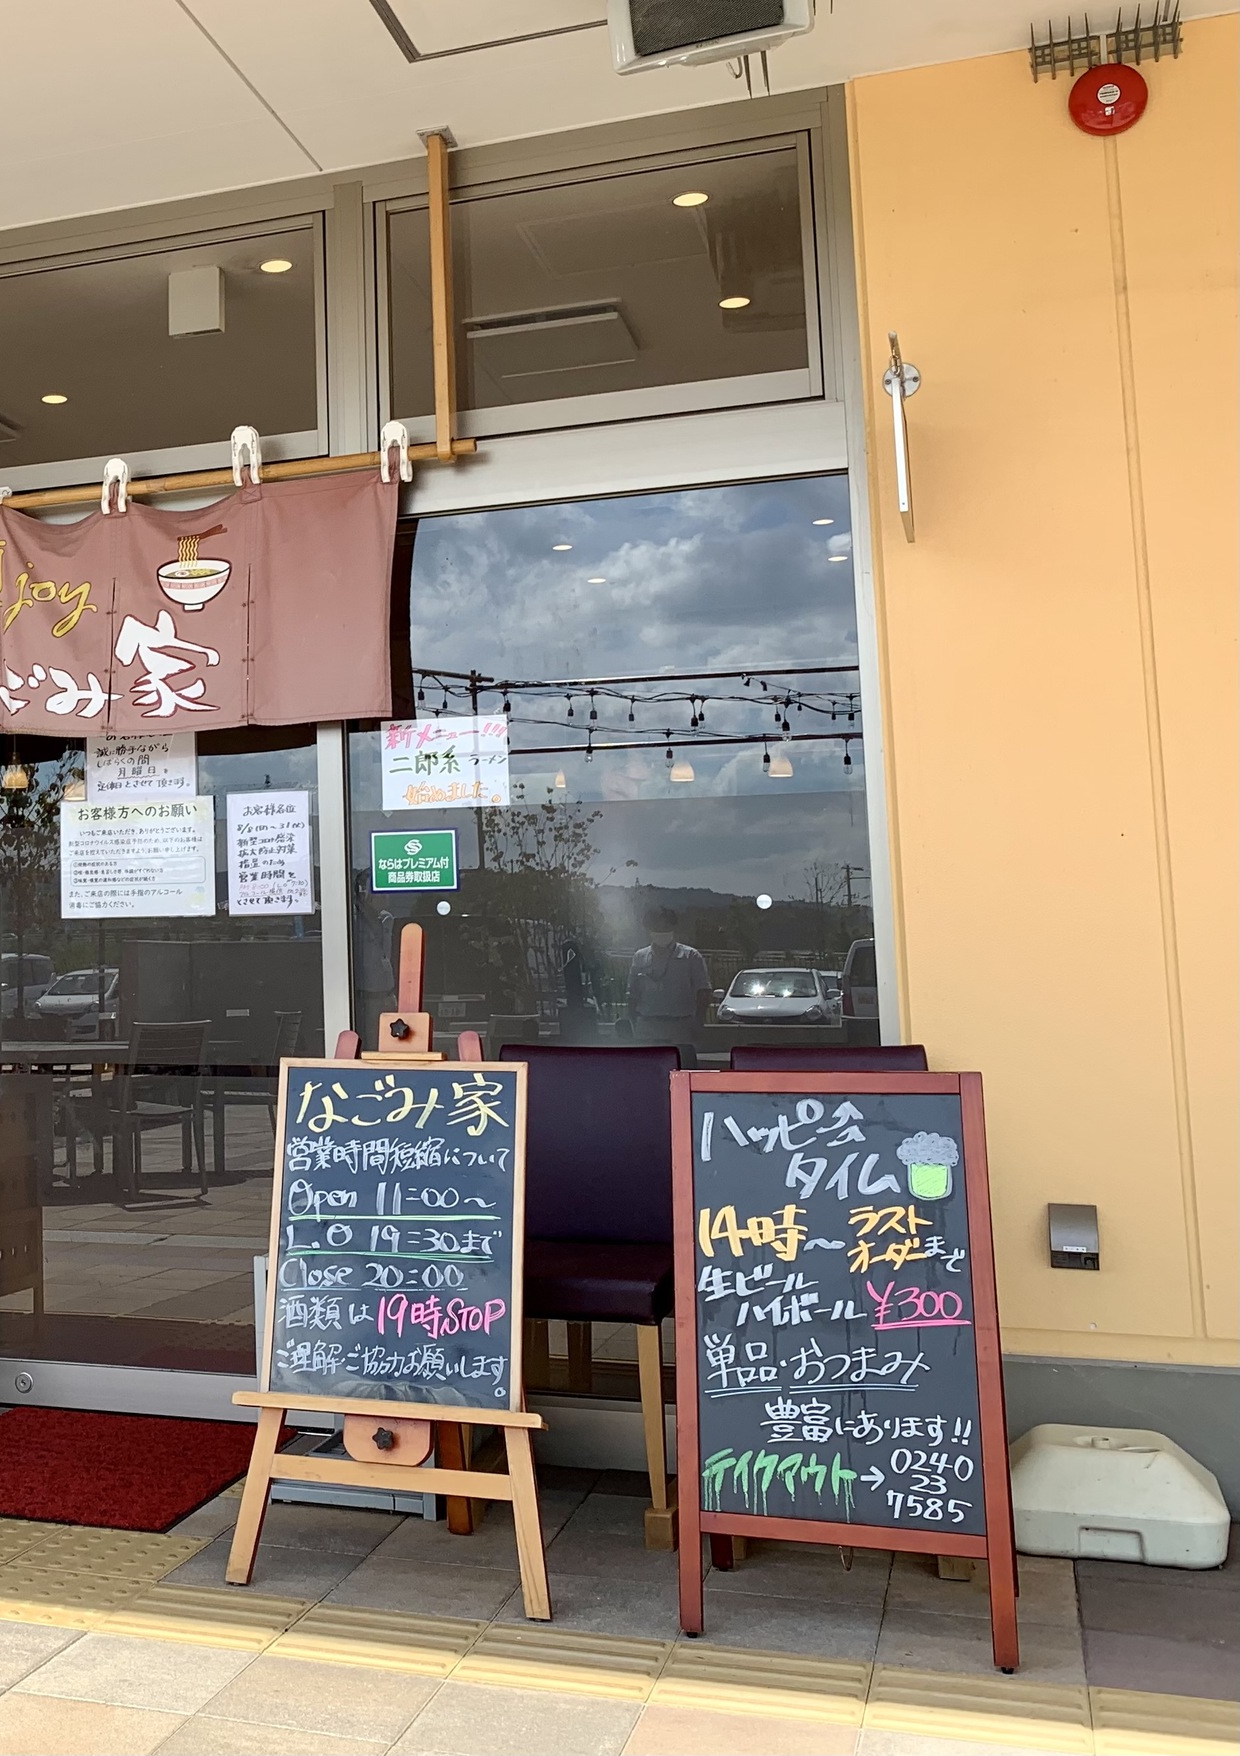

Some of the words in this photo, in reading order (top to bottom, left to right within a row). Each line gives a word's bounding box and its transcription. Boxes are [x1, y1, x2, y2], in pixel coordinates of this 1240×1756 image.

[95, 742, 169, 758] 誠に勝手ながら
[97, 754, 150, 768] しばらくの間
[389, 745, 461, 776] 二郎系
[468, 754, 507, 766] ラーメン
[403, 780, 502, 806] 始めました。
[77, 803, 198, 821] お客様方へのお願い
[378, 856, 450, 870] ならはプレミアム付
[387, 870, 441, 884] 商品券取扱店
[295, 1072, 510, 1136] なごみ家
[286, 1136, 511, 1174] 営業時間短縮について
[785, 1152, 901, 1200] タイム
[848, 1204, 934, 1236] ラスト
[279, 1258, 354, 1289] Close
[697, 1263, 819, 1301] 生ビール
[736, 1291, 868, 1327] ハイボール
[865, 1280, 964, 1325] ¥300
[701, 1447, 858, 1514] テイクアウト
[890, 1448, 975, 1482] 0240
[909, 1474, 949, 1495] 23
[886, 1489, 974, 1524] 7585
